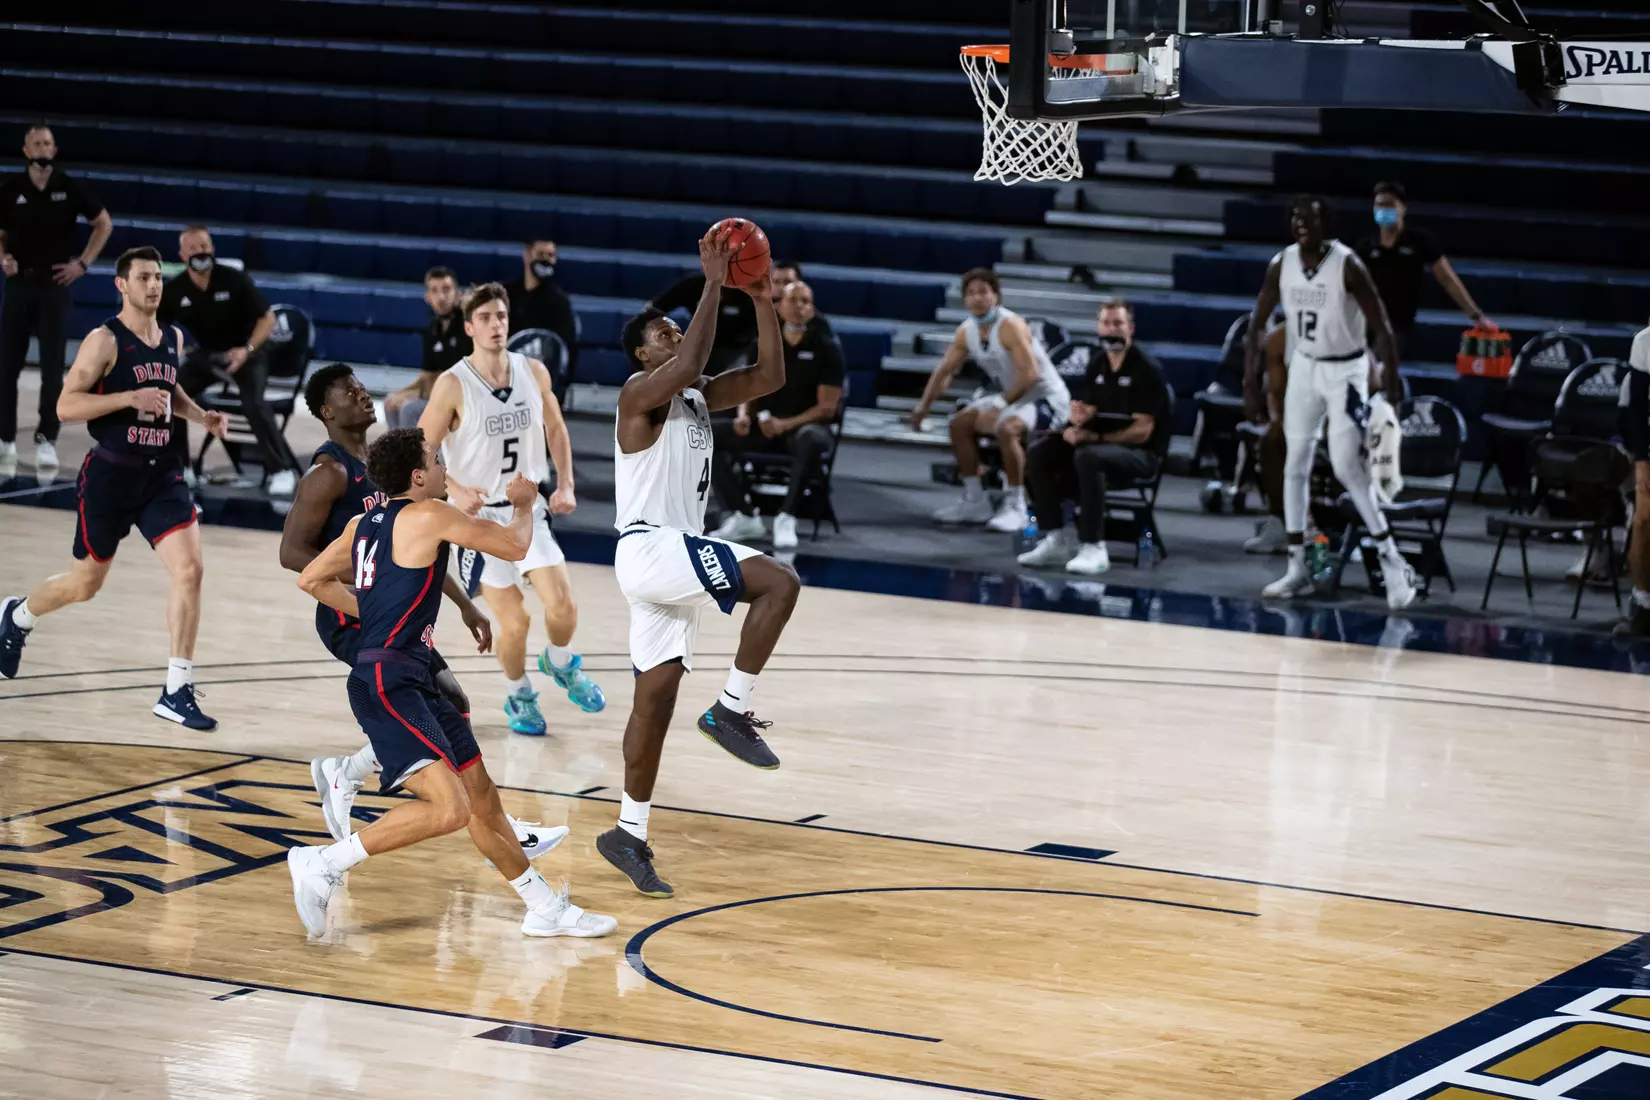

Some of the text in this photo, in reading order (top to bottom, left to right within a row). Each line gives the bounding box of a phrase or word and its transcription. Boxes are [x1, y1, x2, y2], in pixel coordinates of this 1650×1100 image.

[1297, 310, 1318, 342] 12
[485, 407, 531, 436] CBU
[501, 437, 519, 474] 5
[697, 457, 710, 501] 4
[355, 536, 379, 591] 14
[697, 544, 731, 590] LANCERS
